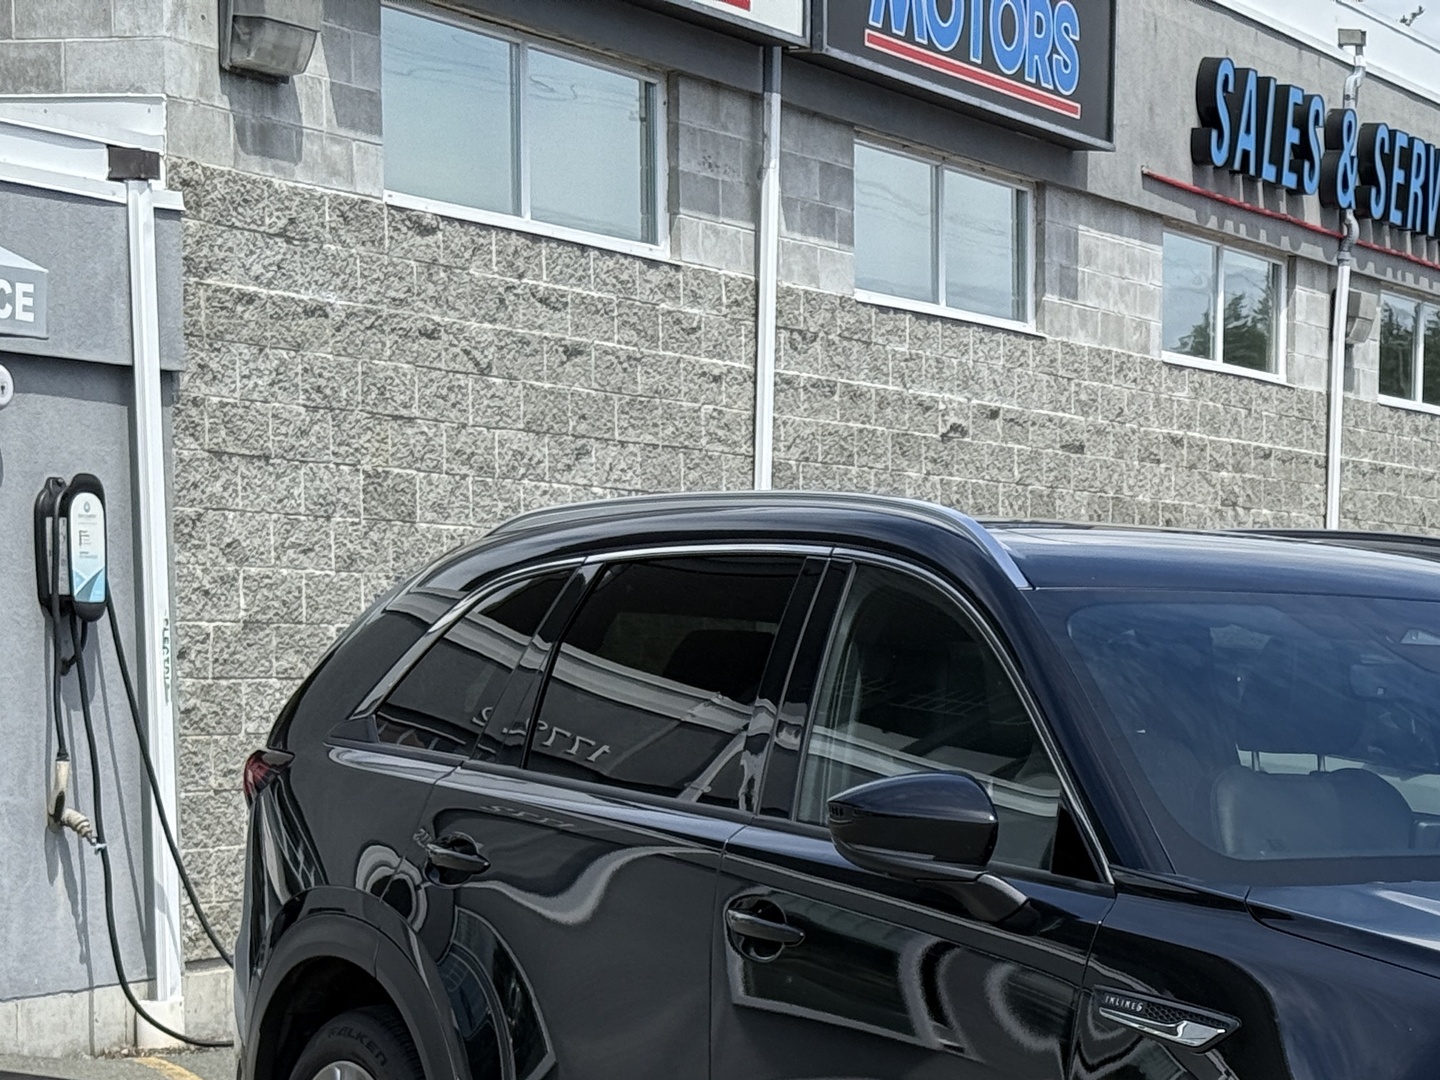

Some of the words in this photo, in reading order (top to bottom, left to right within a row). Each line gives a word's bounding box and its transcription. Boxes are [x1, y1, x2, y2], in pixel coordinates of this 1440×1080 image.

[1210, 58, 1325, 195] SALES
[1335, 108, 1358, 210] &
[327, 1026, 389, 1067] FALKEN
